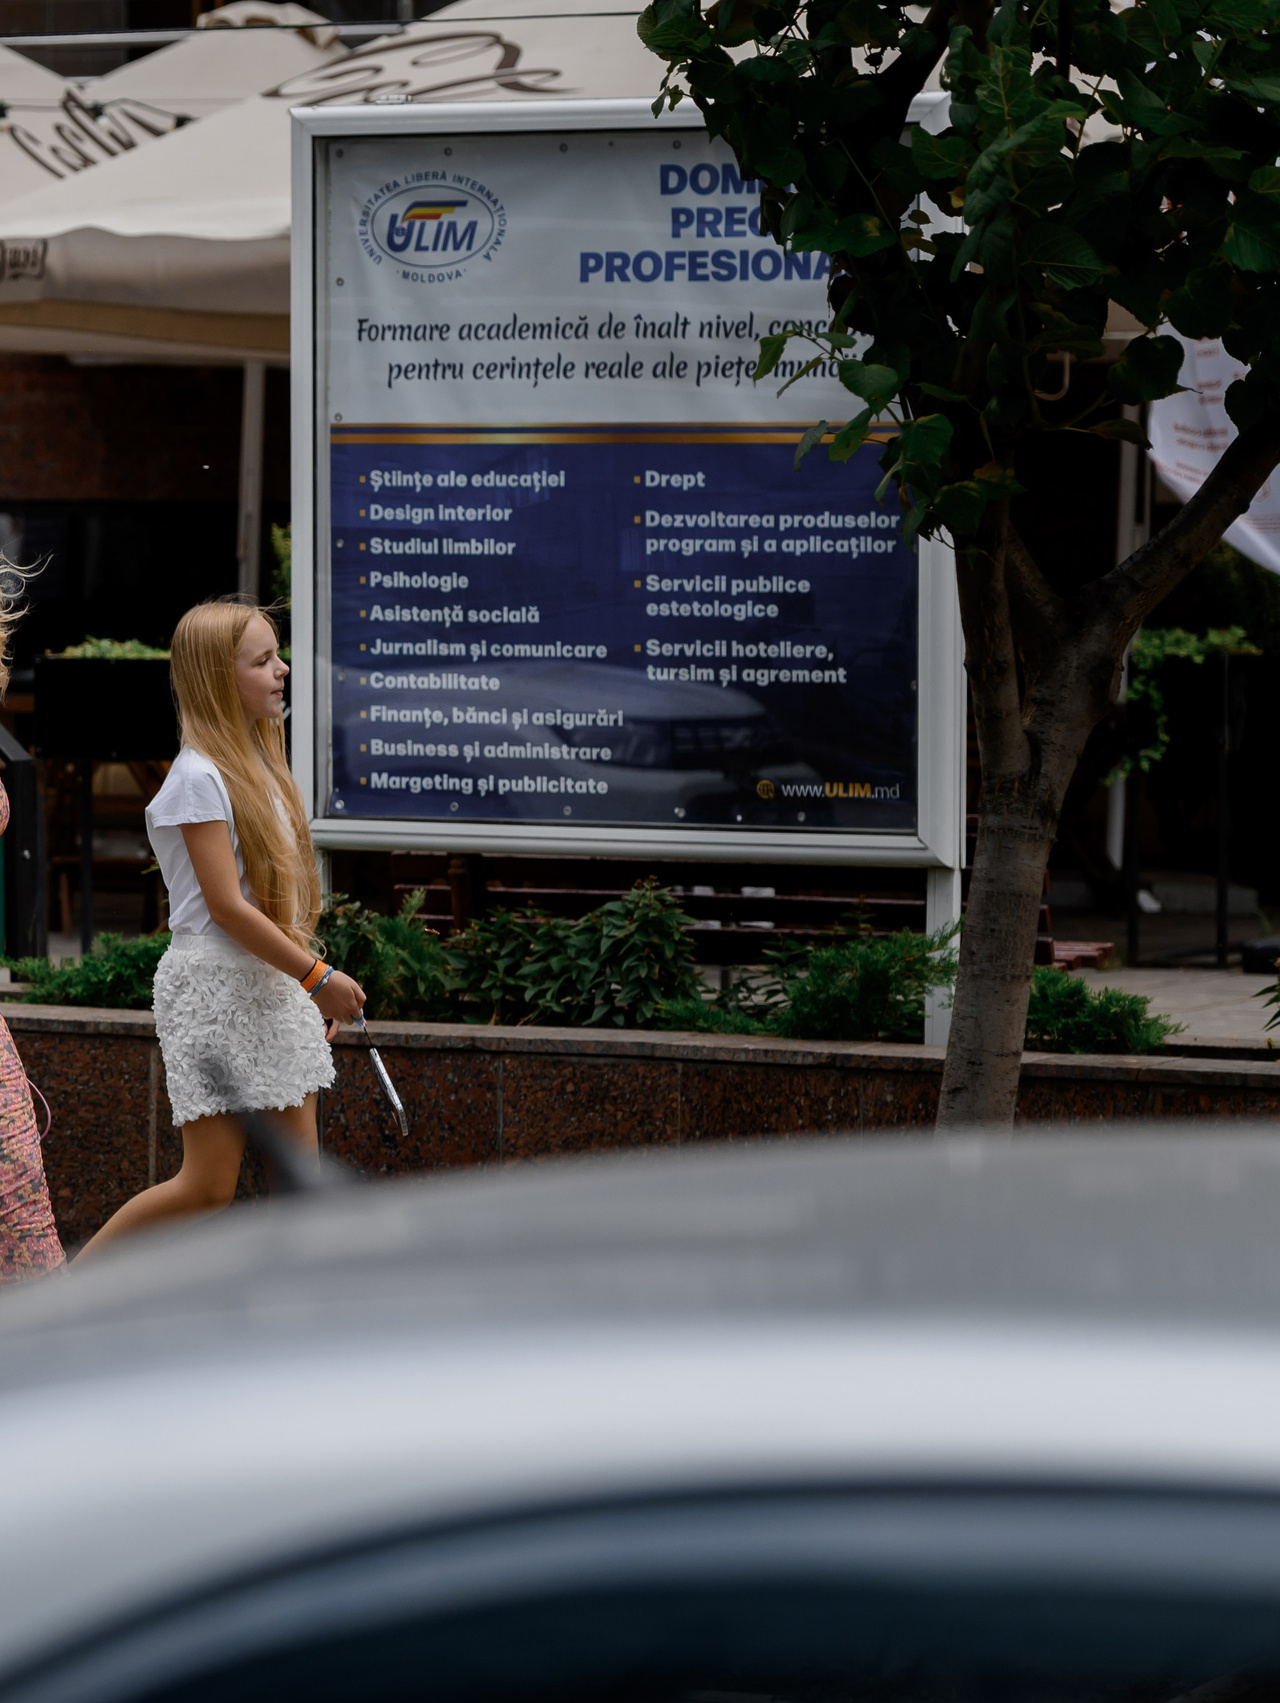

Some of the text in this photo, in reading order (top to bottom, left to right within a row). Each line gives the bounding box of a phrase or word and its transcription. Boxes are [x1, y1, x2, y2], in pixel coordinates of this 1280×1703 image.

[387, 213, 478, 252] ULIM
[402, 269, 464, 283] MOLDOVA
[580, 247, 833, 283] PROFESIONA
[358, 318, 450, 341] Formare
[459, 313, 589, 340] academică
[598, 312, 626, 339] de
[634, 312, 690, 339] înalt
[699, 312, 760, 347] nivel,
[388, 358, 463, 388] pentru
[473, 352, 575, 388] cerințele
[585, 352, 644, 379] reale
[652, 351, 688, 379] ale
[370, 470, 565, 492] Științe ale educației
[646, 471, 705, 490] Drept
[370, 504, 512, 524] Design interior
[646, 511, 899, 531] Dezvoltarea produselor
[370, 537, 516, 554] Studiul limbilor
[646, 536, 896, 558] program și a aplicaților
[370, 571, 468, 592] Psihologie
[646, 575, 810, 596] Servicii publice
[370, 605, 539, 627] Asistență socială
[646, 600, 778, 621] estetologice
[371, 639, 607, 661] Jurnalism și comunicare
[646, 639, 833, 661] Servicii hoteliere,
[370, 672, 500, 690] Contabilitate
[646, 665, 846, 687] tursim și agrement
[370, 705, 623, 730] Finanțe, bănci și asigurări
[371, 738, 611, 762] Business și administrare
[371, 772, 608, 796] Margeting și publicitate
[782, 783, 899, 798] www.ULIM.md
